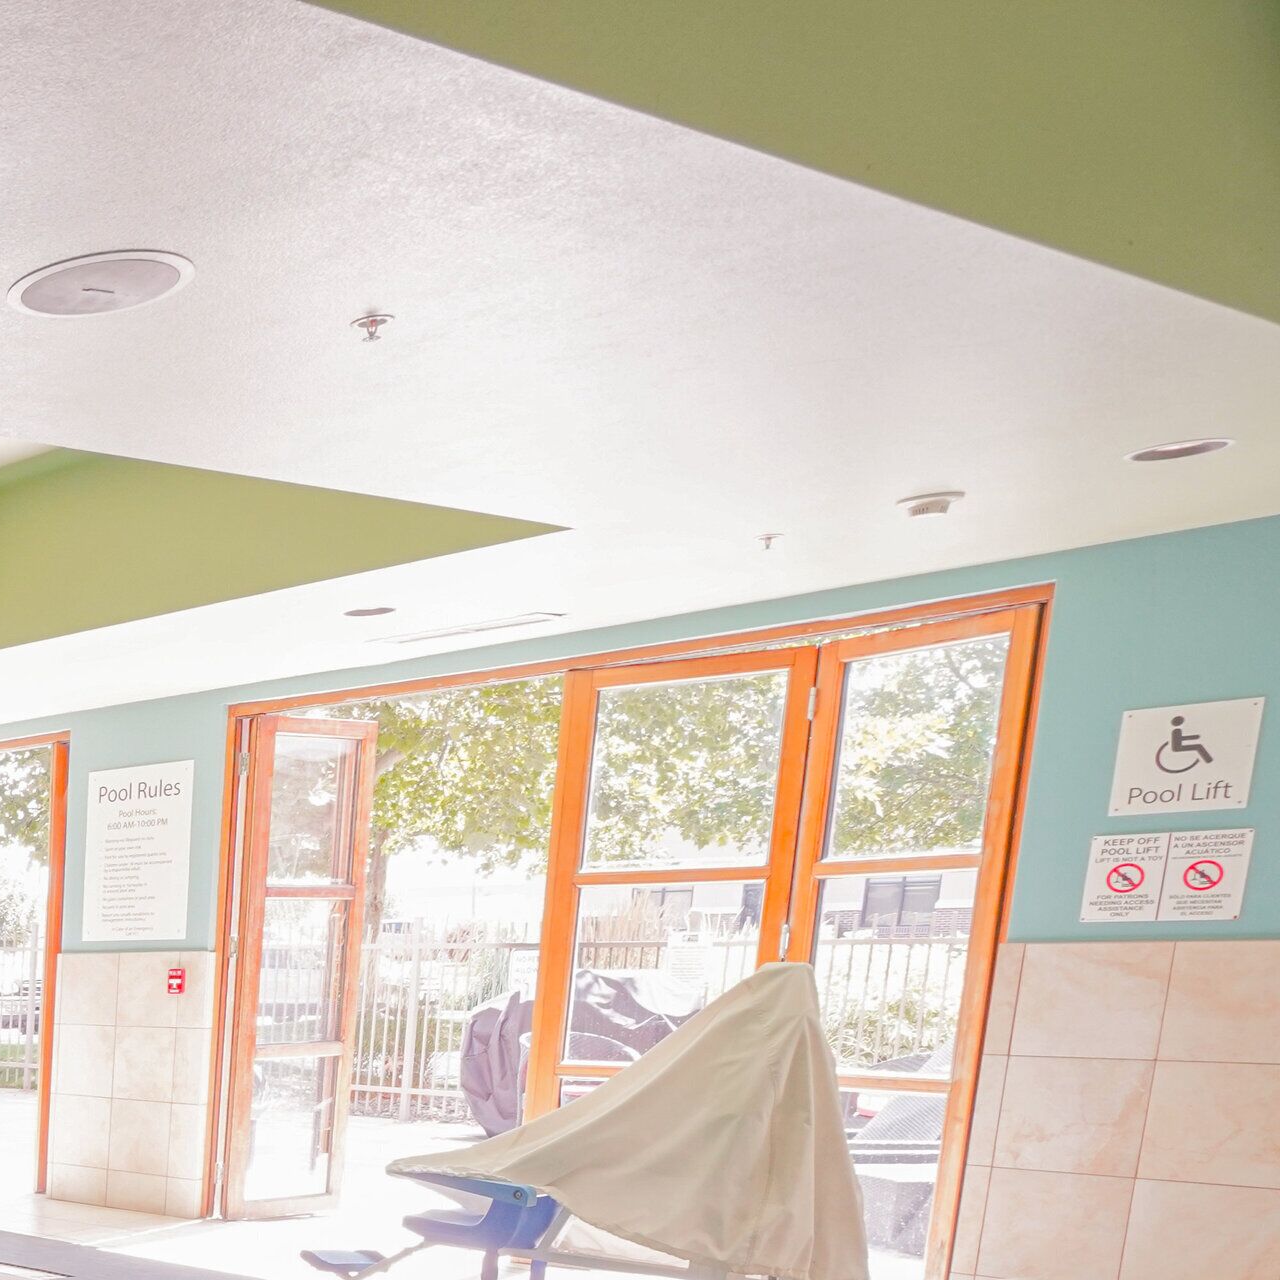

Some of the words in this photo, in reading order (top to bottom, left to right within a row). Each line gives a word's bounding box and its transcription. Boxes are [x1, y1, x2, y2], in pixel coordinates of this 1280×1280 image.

[99, 782, 132, 803] Pool
[138, 779, 181, 799] Rules
[1128, 784, 1182, 804] Pool
[1191, 780, 1232, 800] Lift
[1103, 838, 1134, 846] KEEP
[1137, 837, 1160, 845] OFF
[1101, 847, 1132, 855] POOL
[1136, 846, 1160, 854] LIFT
